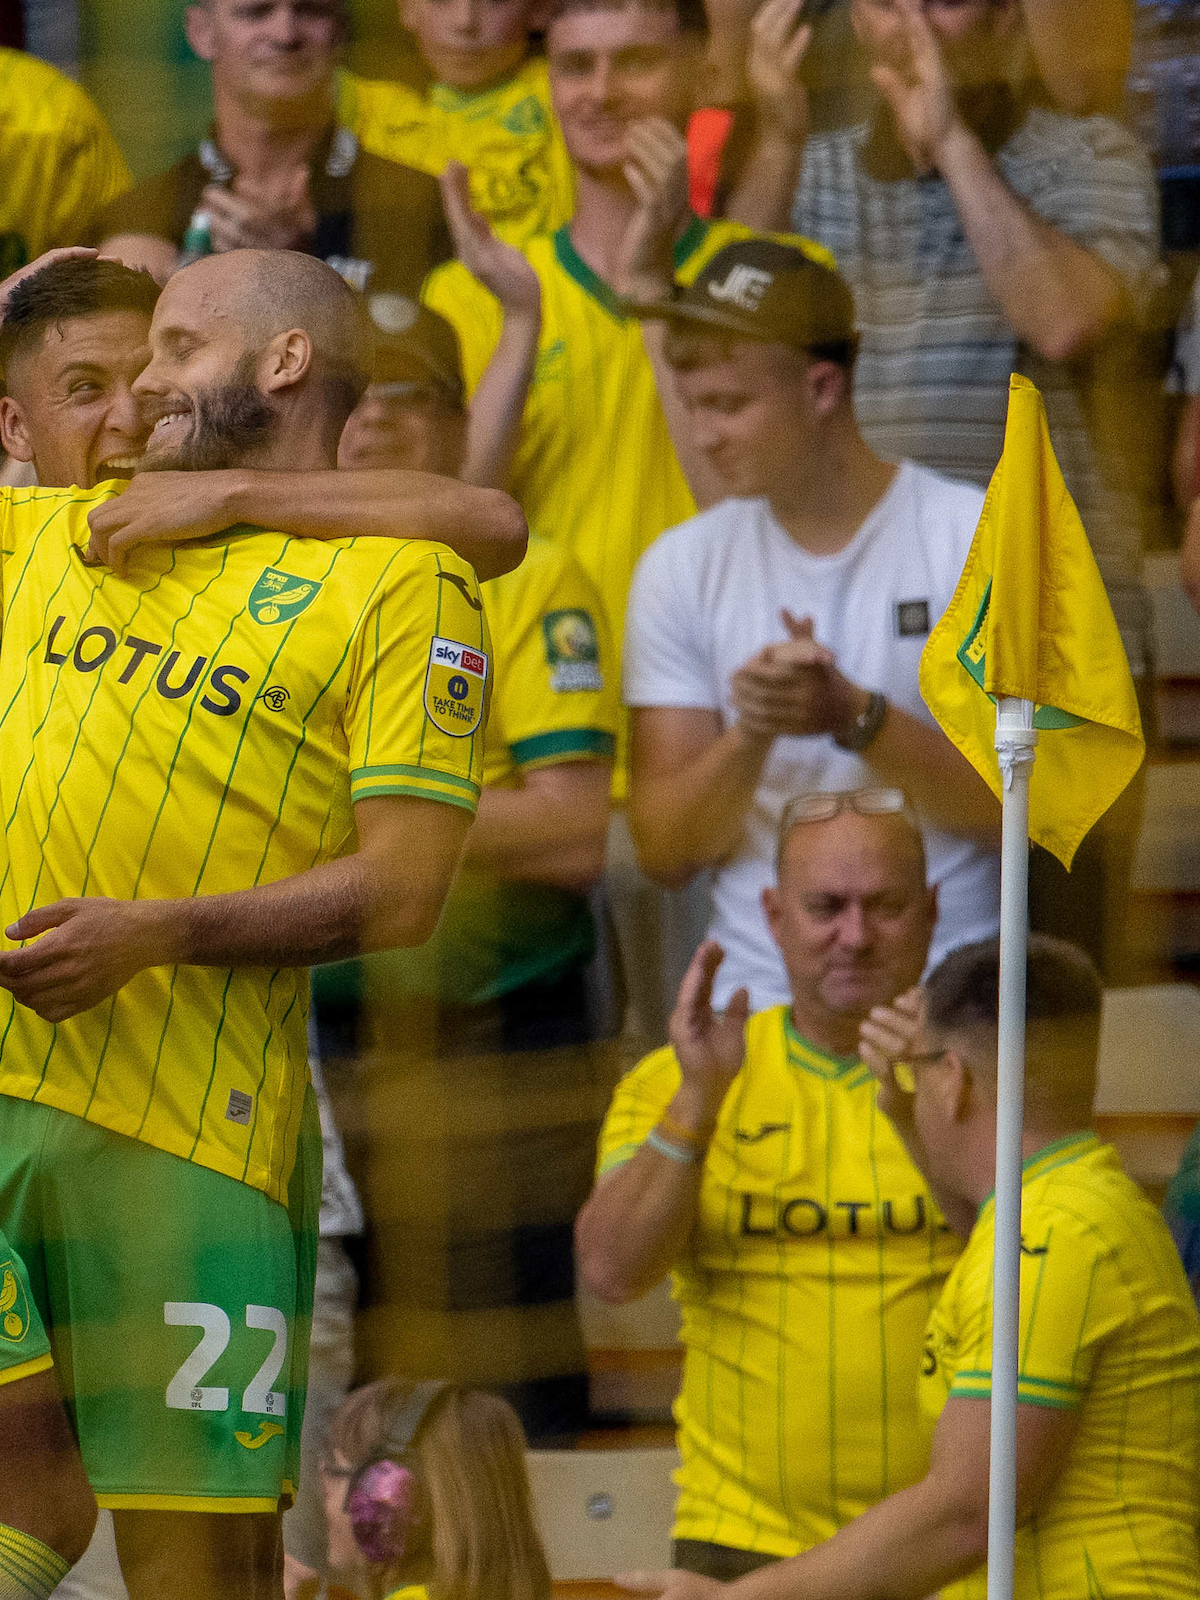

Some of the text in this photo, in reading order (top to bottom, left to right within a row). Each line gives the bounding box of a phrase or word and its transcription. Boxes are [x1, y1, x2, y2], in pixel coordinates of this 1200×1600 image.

[44, 615, 251, 717] LOTUS
[436, 646, 483, 671] sky bet
[433, 696, 475, 717] TAKE TIME
[435, 705, 447, 715] TO
[741, 1191, 949, 1237] LOTU
[164, 1302, 288, 1417] 22
